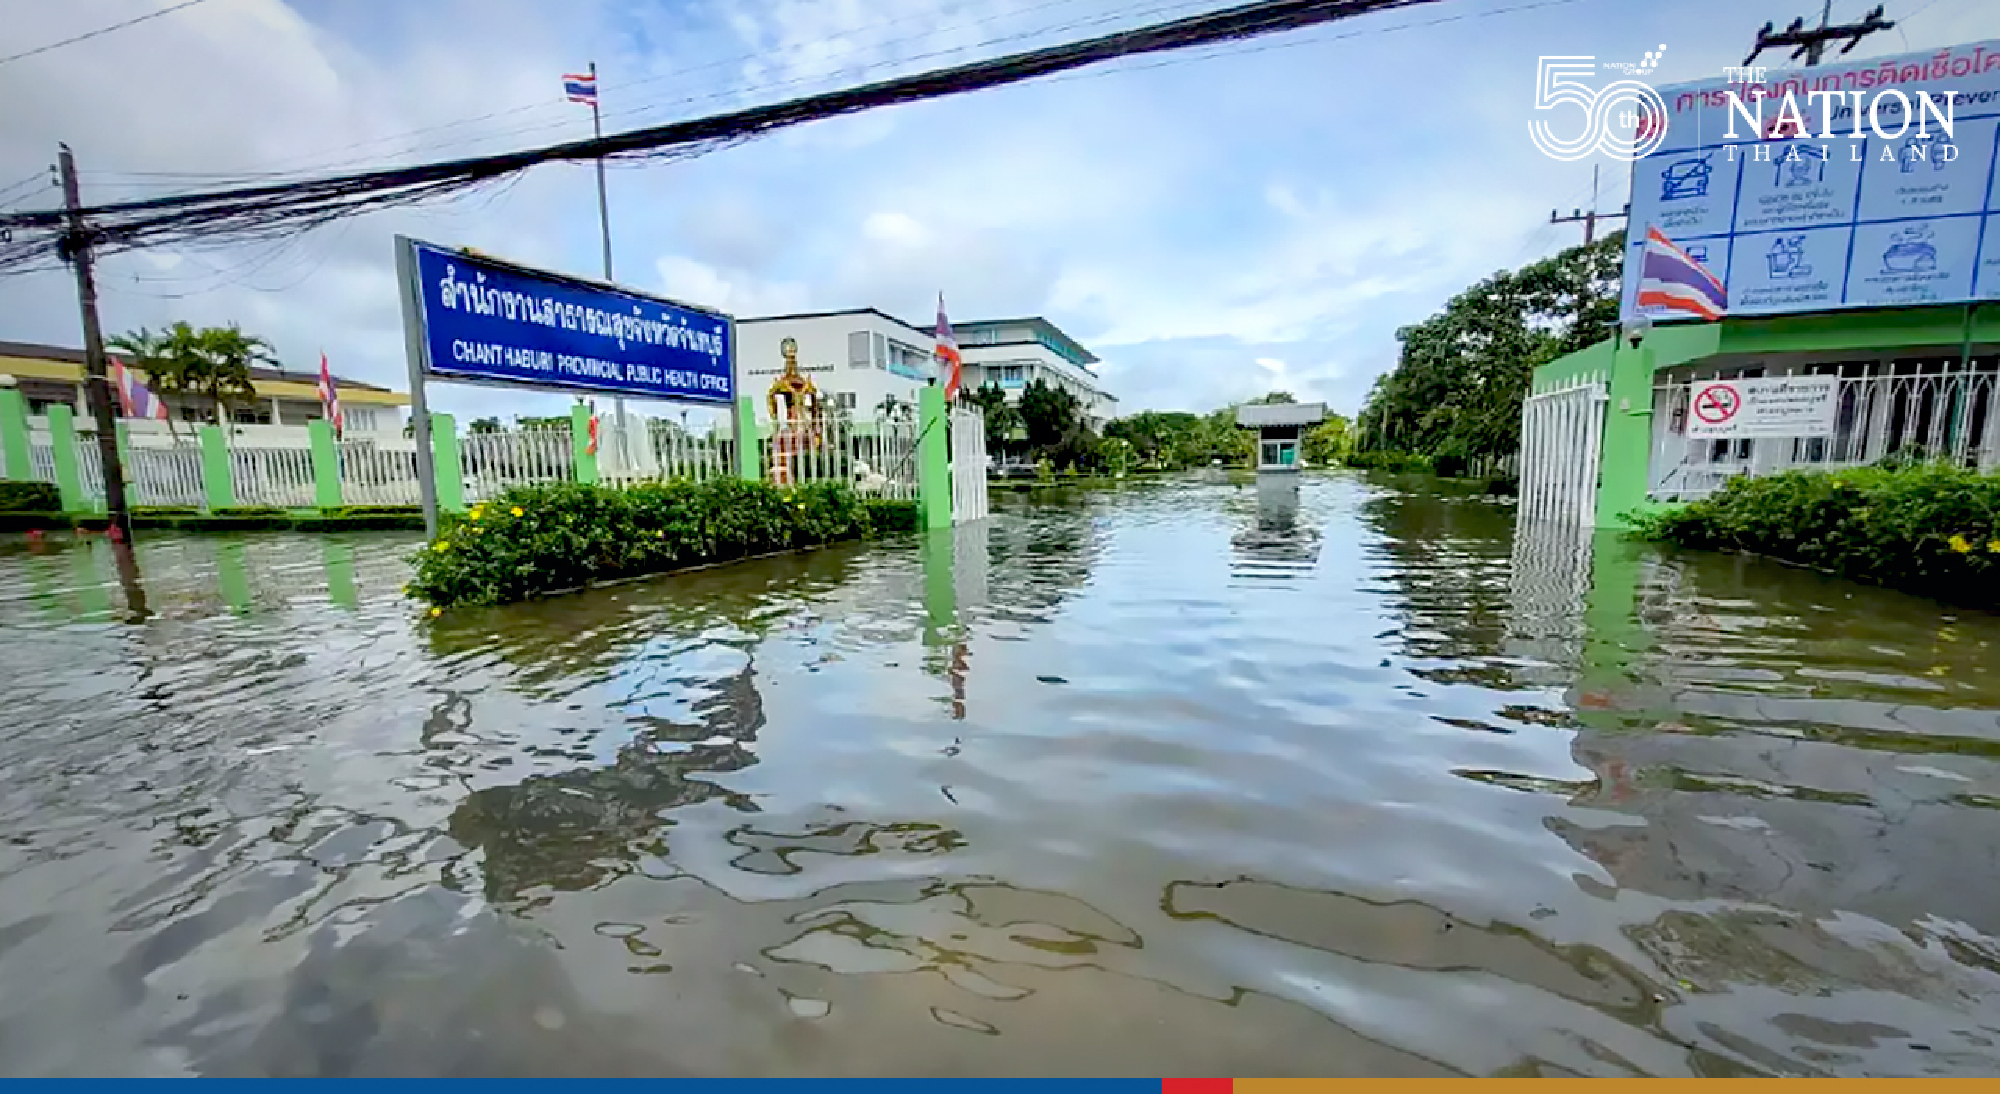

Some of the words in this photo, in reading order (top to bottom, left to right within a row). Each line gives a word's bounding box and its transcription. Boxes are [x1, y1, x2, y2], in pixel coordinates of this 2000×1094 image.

[557, 353, 624, 381] PROVINCIAL
[627, 363, 662, 384] PUBLIC
[664, 369, 699, 389] HEALTH
[701, 374, 729, 392] OFFICE
